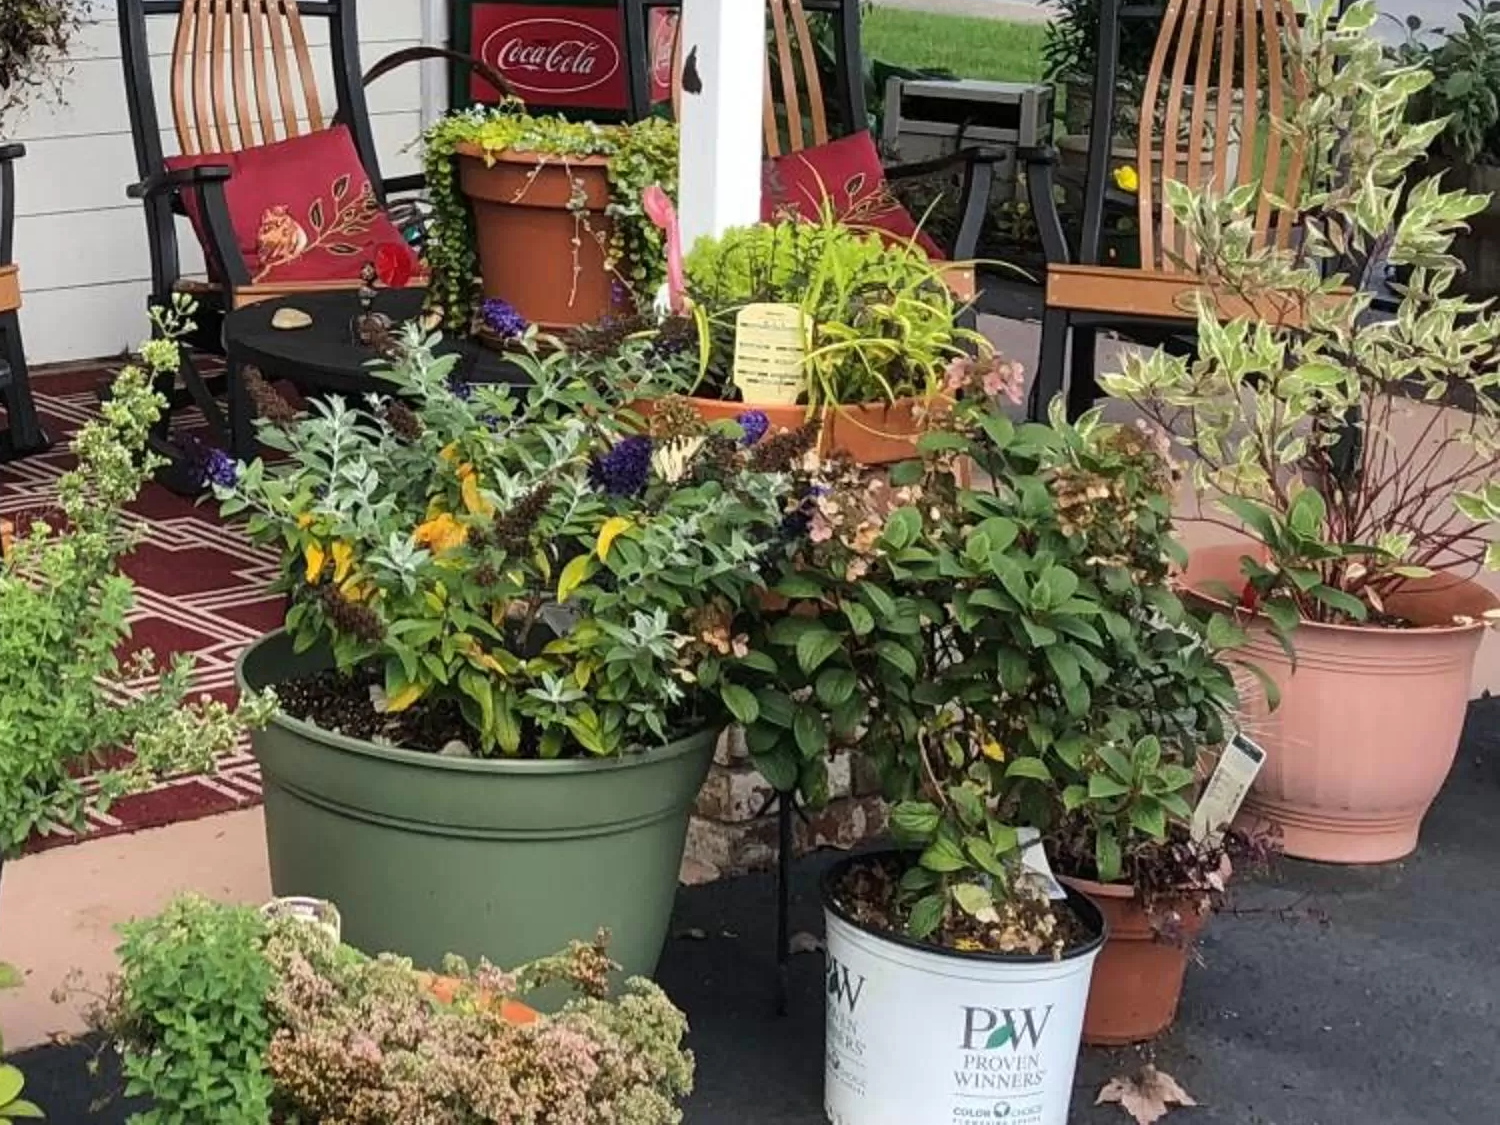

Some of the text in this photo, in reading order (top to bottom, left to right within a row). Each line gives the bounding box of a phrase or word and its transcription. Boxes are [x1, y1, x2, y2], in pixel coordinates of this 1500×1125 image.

[957, 1002, 1056, 1052] PW
[963, 1053, 1040, 1072] PROVEN
[952, 1070, 1046, 1089] WINNERS
